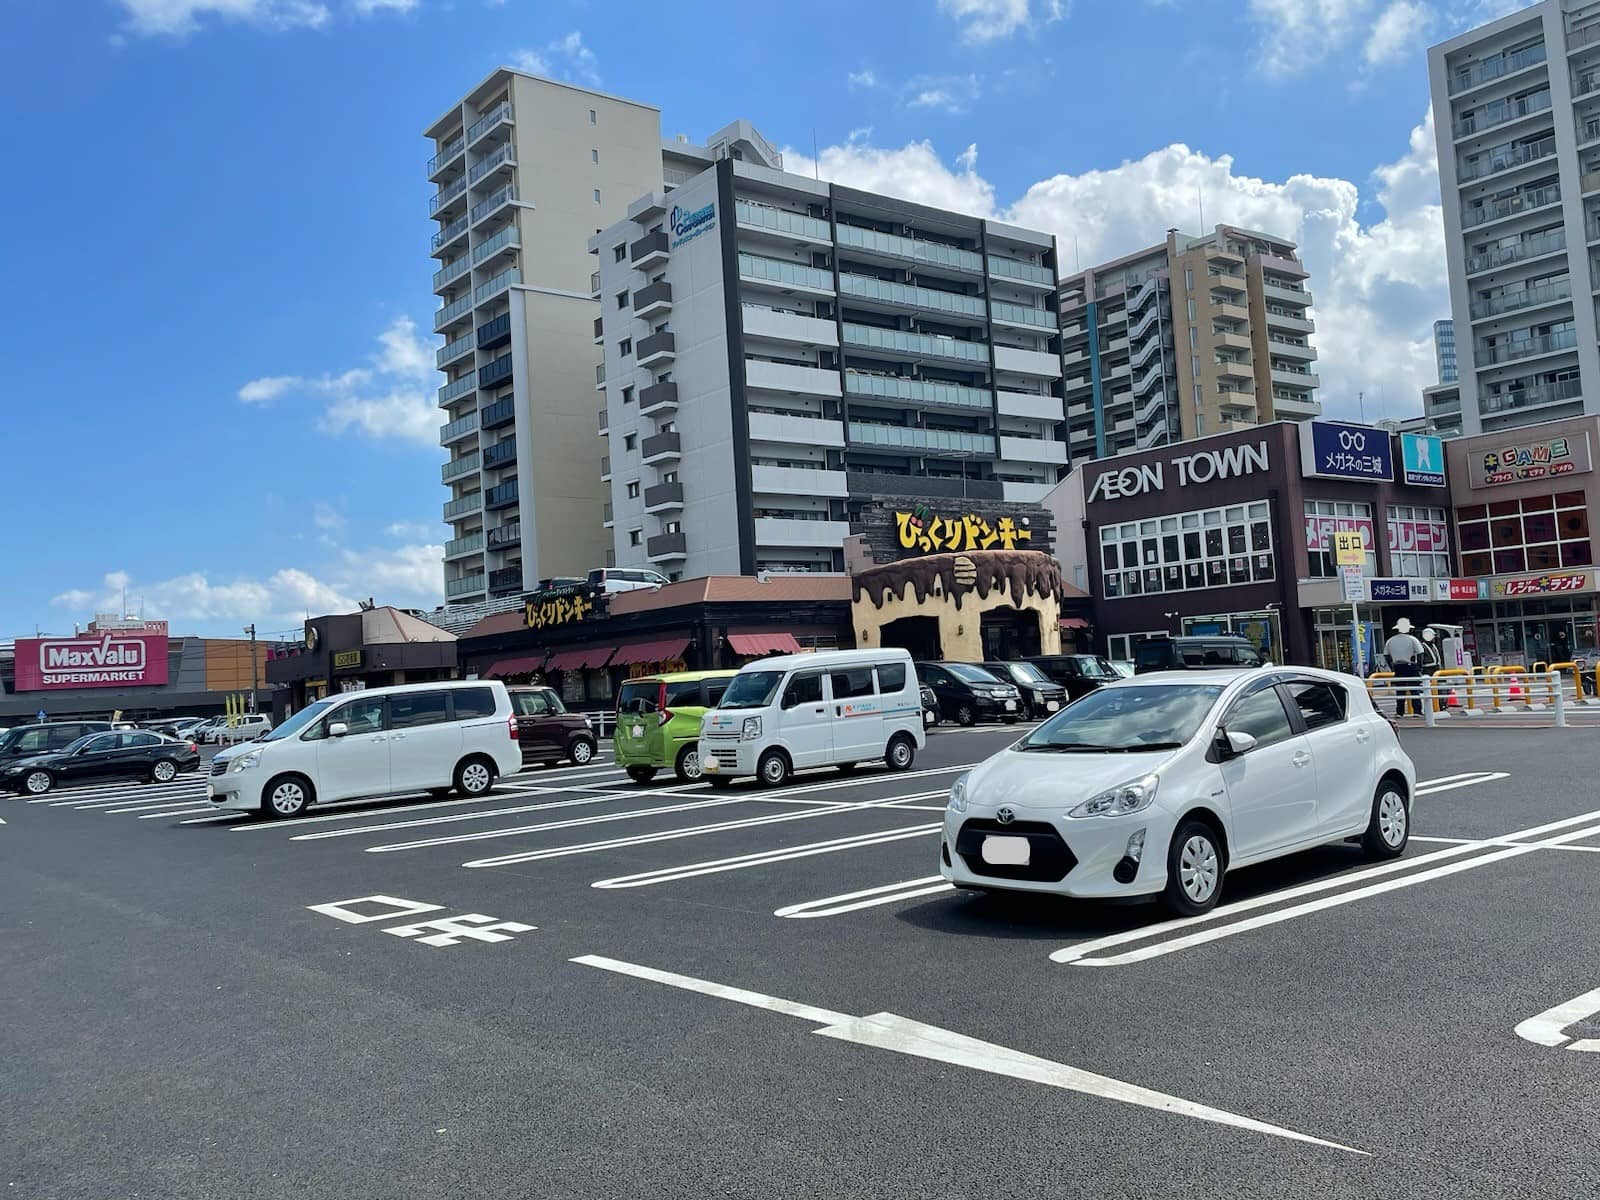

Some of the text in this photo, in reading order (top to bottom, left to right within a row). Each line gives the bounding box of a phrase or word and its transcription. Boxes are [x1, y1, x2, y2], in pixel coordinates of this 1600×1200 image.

[1171, 441, 1269, 486] TOWN
[1325, 452, 1383, 474] メガネの三城
[1502, 438, 1569, 465] GAME
[895, 511, 1032, 552] びっくりドンキー
[1339, 536, 1361, 549] 出口
[1506, 575, 1585, 595] レジャーランド
[526, 595, 593, 629] びっくりドンキー
[48, 635, 138, 667] MaxValu
[43, 670, 145, 684] SUPERMARKET
